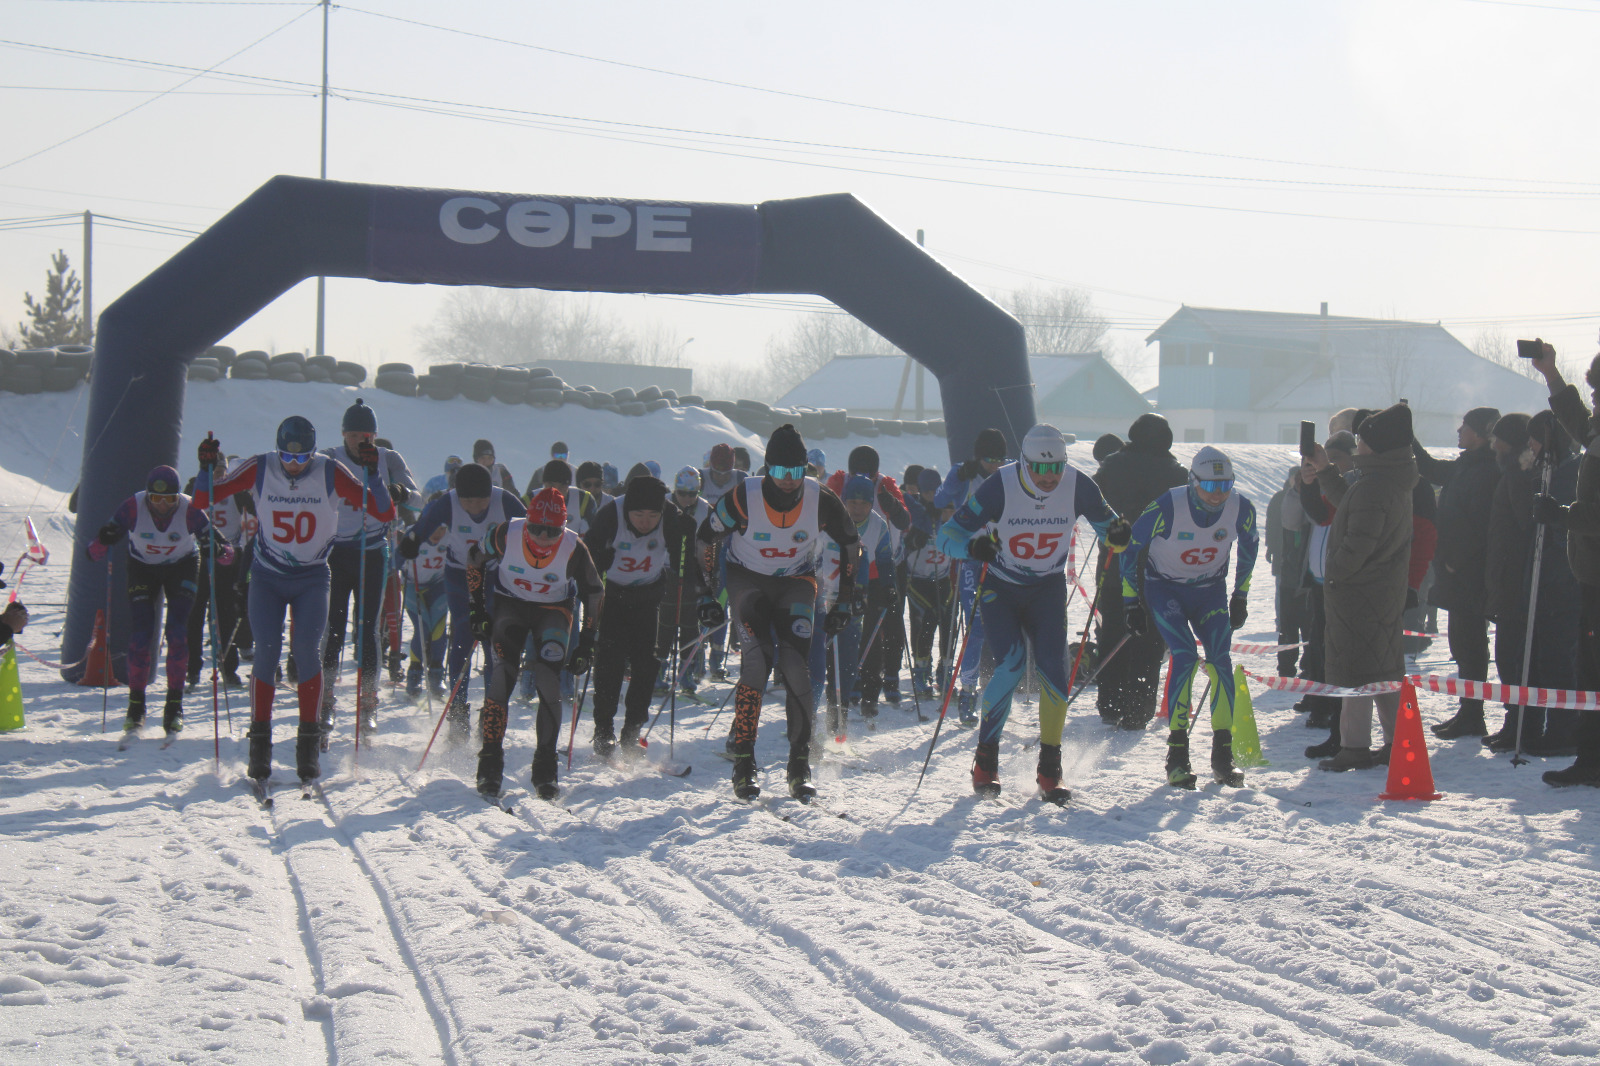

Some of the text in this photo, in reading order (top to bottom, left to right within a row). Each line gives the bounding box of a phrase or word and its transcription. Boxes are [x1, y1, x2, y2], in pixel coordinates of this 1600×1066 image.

[439, 197, 692, 252] СӨРЕ
[267, 495, 322, 504] ҚАРҚАРАЛЫ
[272, 510, 316, 544] 50
[1008, 517, 1068, 526] ҚАРҚАРАЛЫ
[145, 544, 177, 555] 57
[1009, 532, 1063, 560] 65
[423, 556, 443, 569] 12
[617, 556, 653, 572] 34
[925, 550, 945, 564] 23
[1180, 547, 1218, 566] 63
